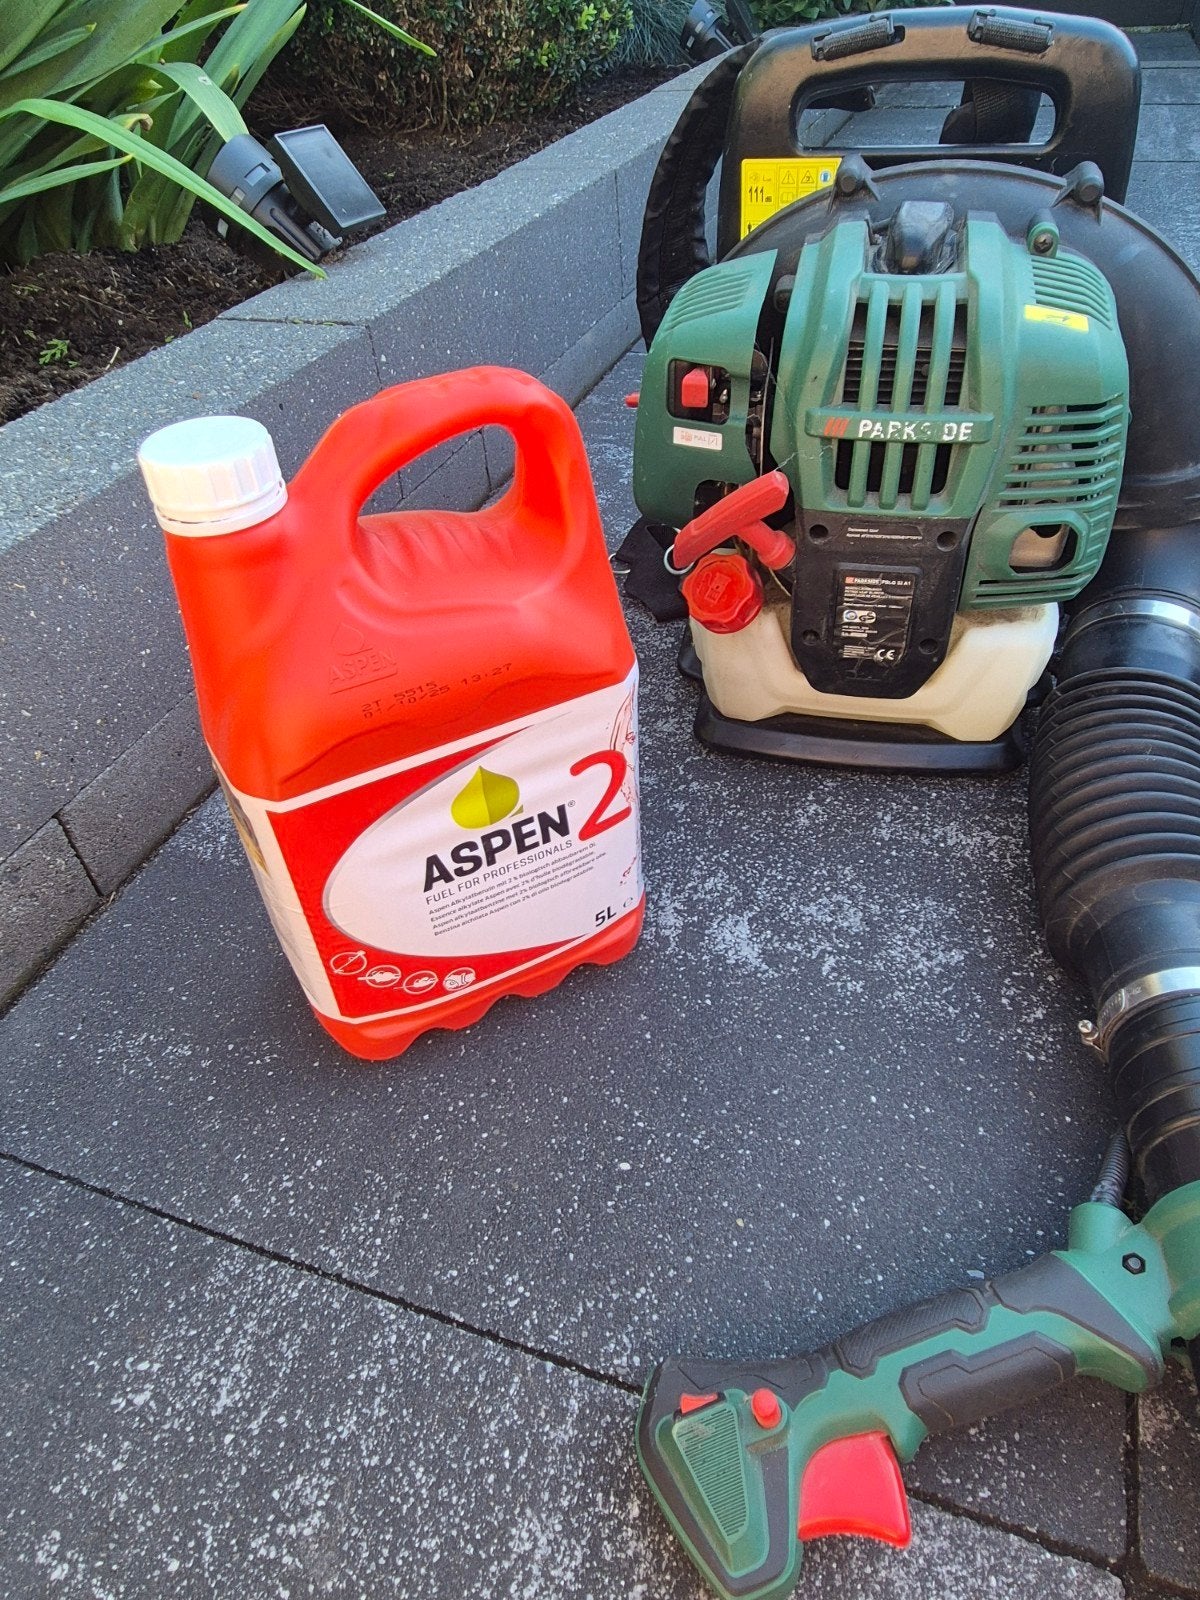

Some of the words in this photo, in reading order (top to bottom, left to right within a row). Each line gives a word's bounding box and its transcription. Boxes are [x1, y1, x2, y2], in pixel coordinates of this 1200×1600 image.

[748, 185, 764, 203] 111
[858, 419, 974, 442] PARKSDE
[877, 649, 896, 660] CE
[329, 650, 398, 684] ASPEN
[423, 803, 571, 893] ASPEN
[570, 749, 632, 841] 2
[426, 888, 455, 905] FUEL
[458, 877, 480, 892] FOR
[483, 840, 572, 882] PROFESSIONALS
[429, 903, 450, 915] Aspen
[430, 909, 456, 922] Essence
[458, 897, 483, 912] alkylate
[485, 890, 505, 901] Aspen
[489, 903, 509, 914] Aspen
[595, 905, 617, 927] 5L
[433, 918, 454, 929] Aspen
